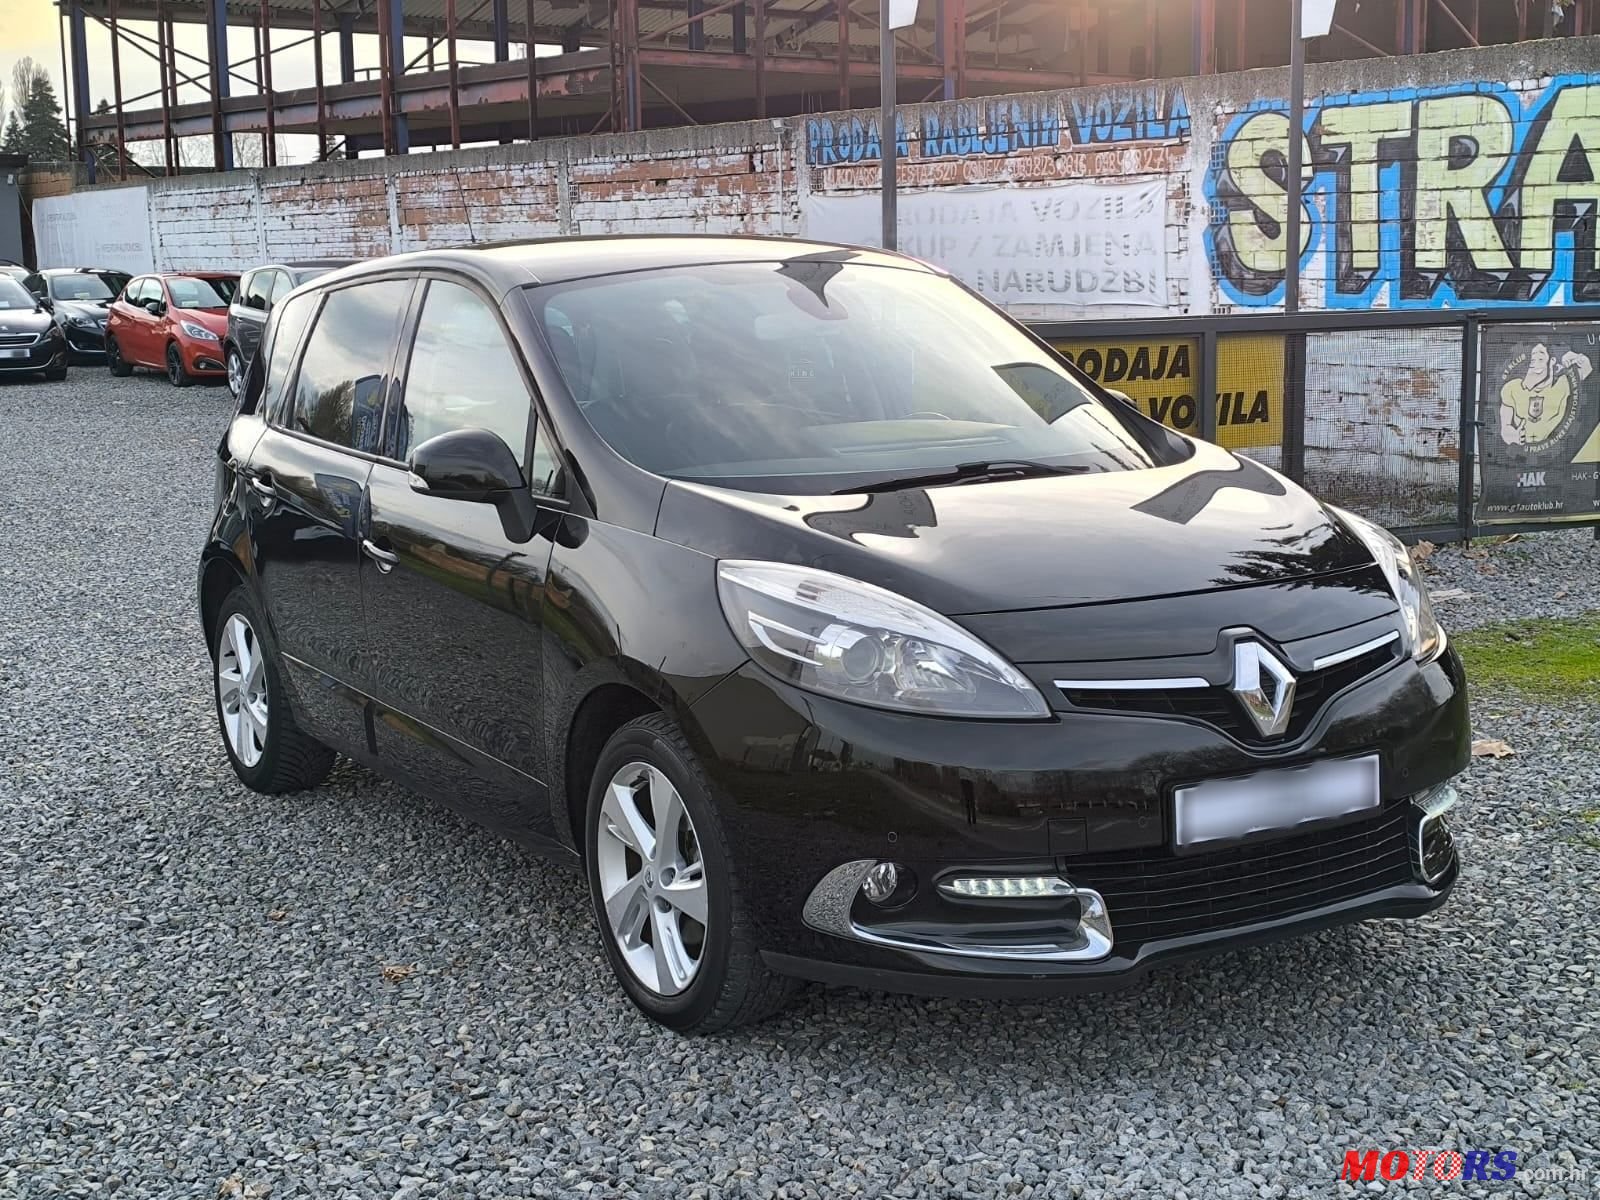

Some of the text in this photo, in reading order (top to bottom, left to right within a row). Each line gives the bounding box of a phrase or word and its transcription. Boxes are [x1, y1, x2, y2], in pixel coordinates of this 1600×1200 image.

[806, 84, 1190, 165] PRODAA RABLJENIH VOZILA
[1031, 192, 1154, 222] VOZILA
[992, 232, 1157, 258] ZAMJENA
[977, 258, 1156, 294] NARUDŽBI
[1517, 471, 1546, 488] HAK
